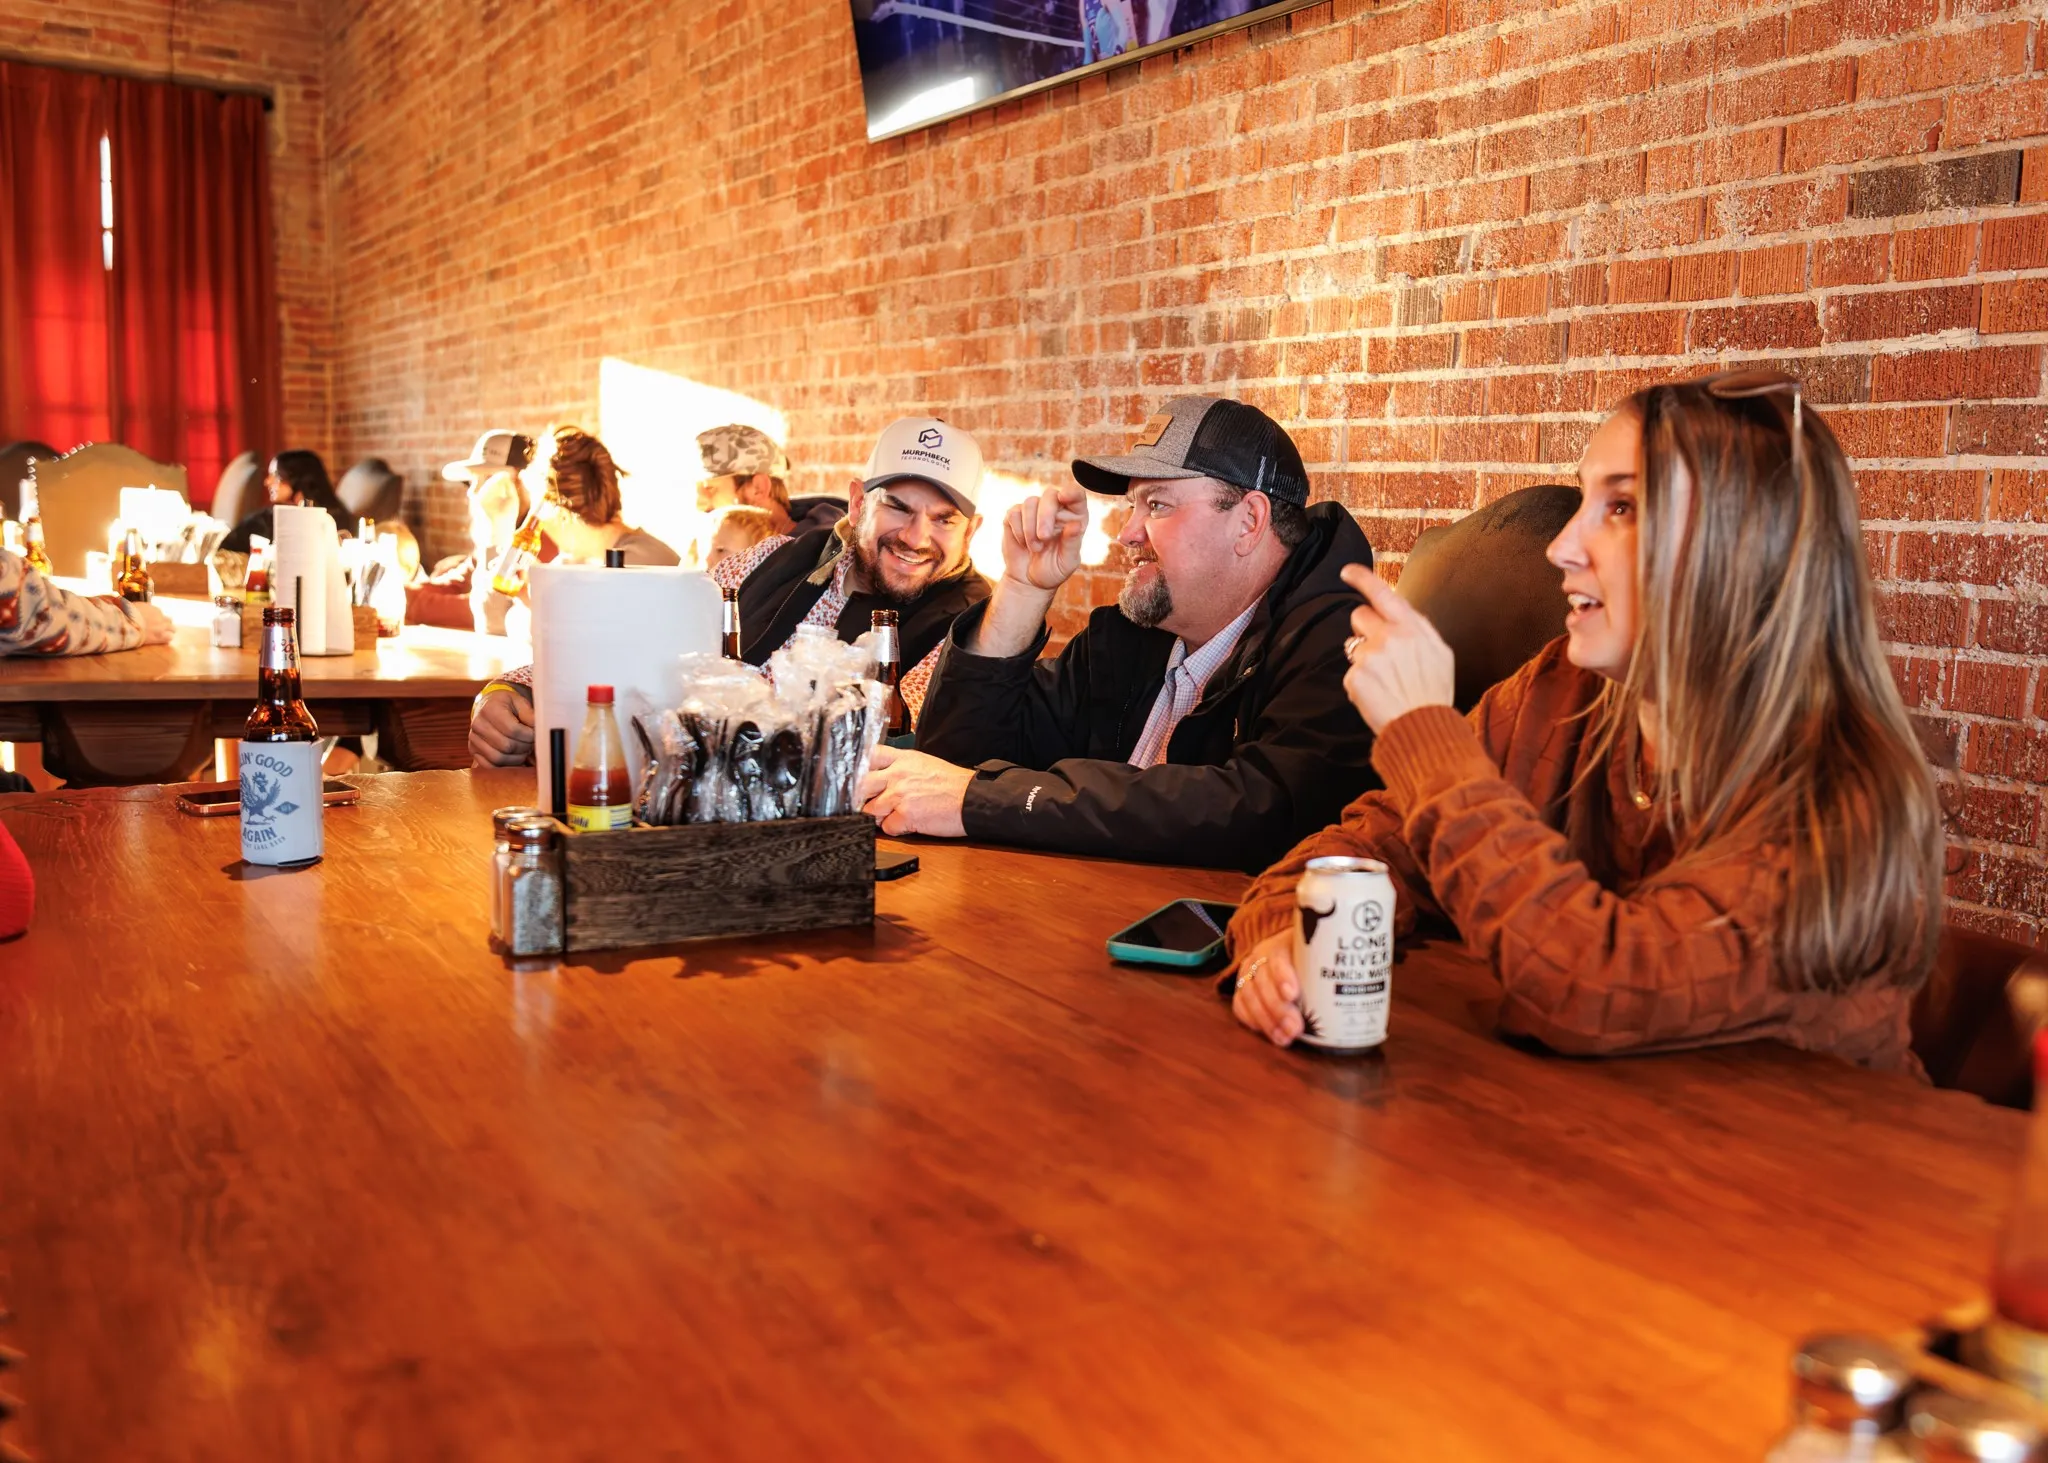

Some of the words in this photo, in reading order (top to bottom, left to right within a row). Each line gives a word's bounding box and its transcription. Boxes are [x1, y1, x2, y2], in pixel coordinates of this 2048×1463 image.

[901, 456, 950, 471] TECHNOLOGIES
[902, 449, 951, 465] MURPHBECK
[255, 753, 293, 777] GOOD
[242, 827, 277, 842] AGAIN
[1338, 933, 1387, 950] LONE
[1334, 951, 1388, 966] RIVER
